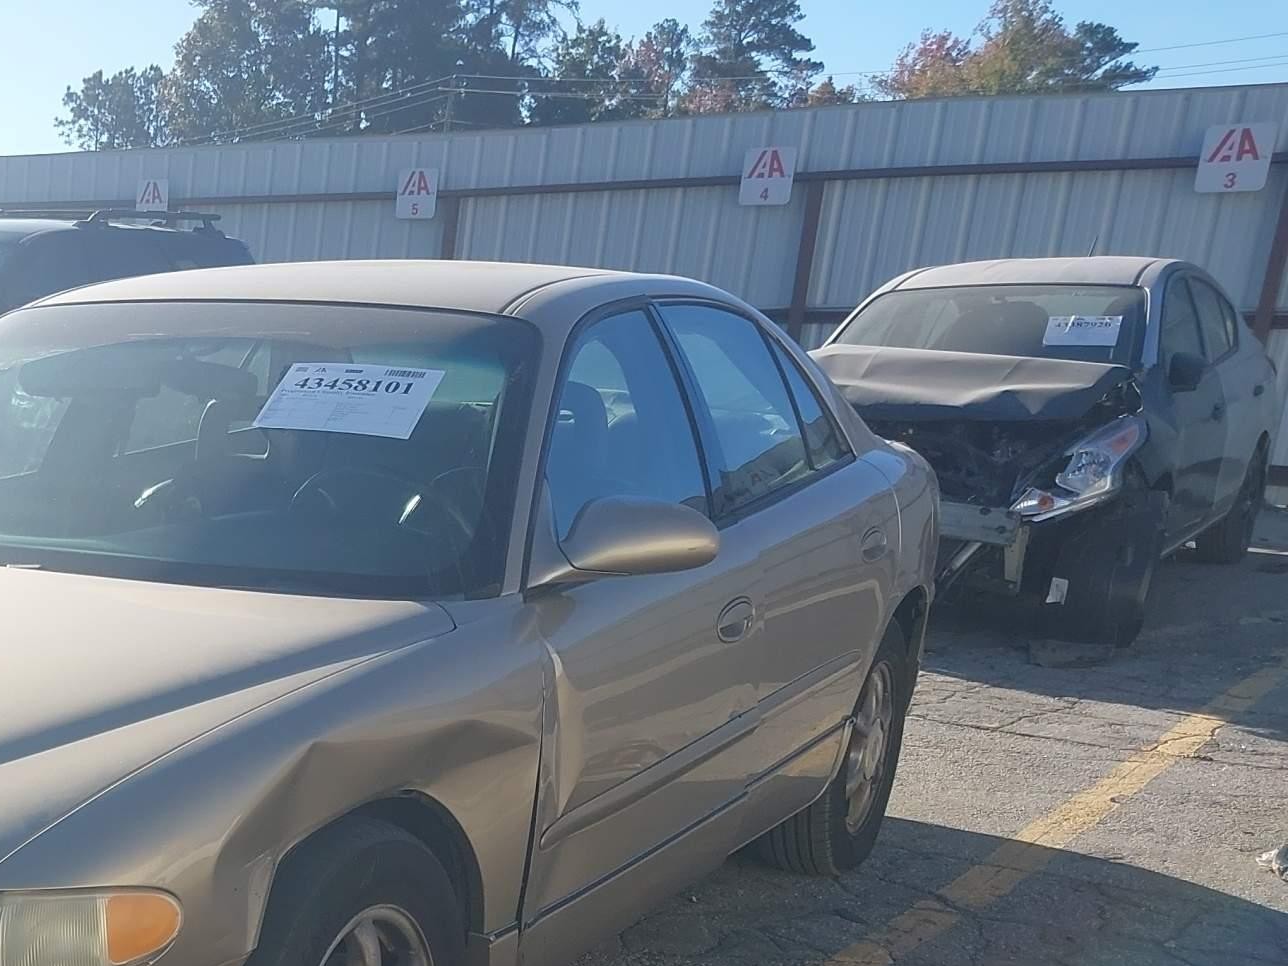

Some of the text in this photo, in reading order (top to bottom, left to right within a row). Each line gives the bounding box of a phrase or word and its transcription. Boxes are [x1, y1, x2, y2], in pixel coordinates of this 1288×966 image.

[1224, 172, 1236, 189] 3
[759, 187, 769, 201] 4
[411, 203, 418, 216] 5
[294, 377, 414, 395] 43458101
